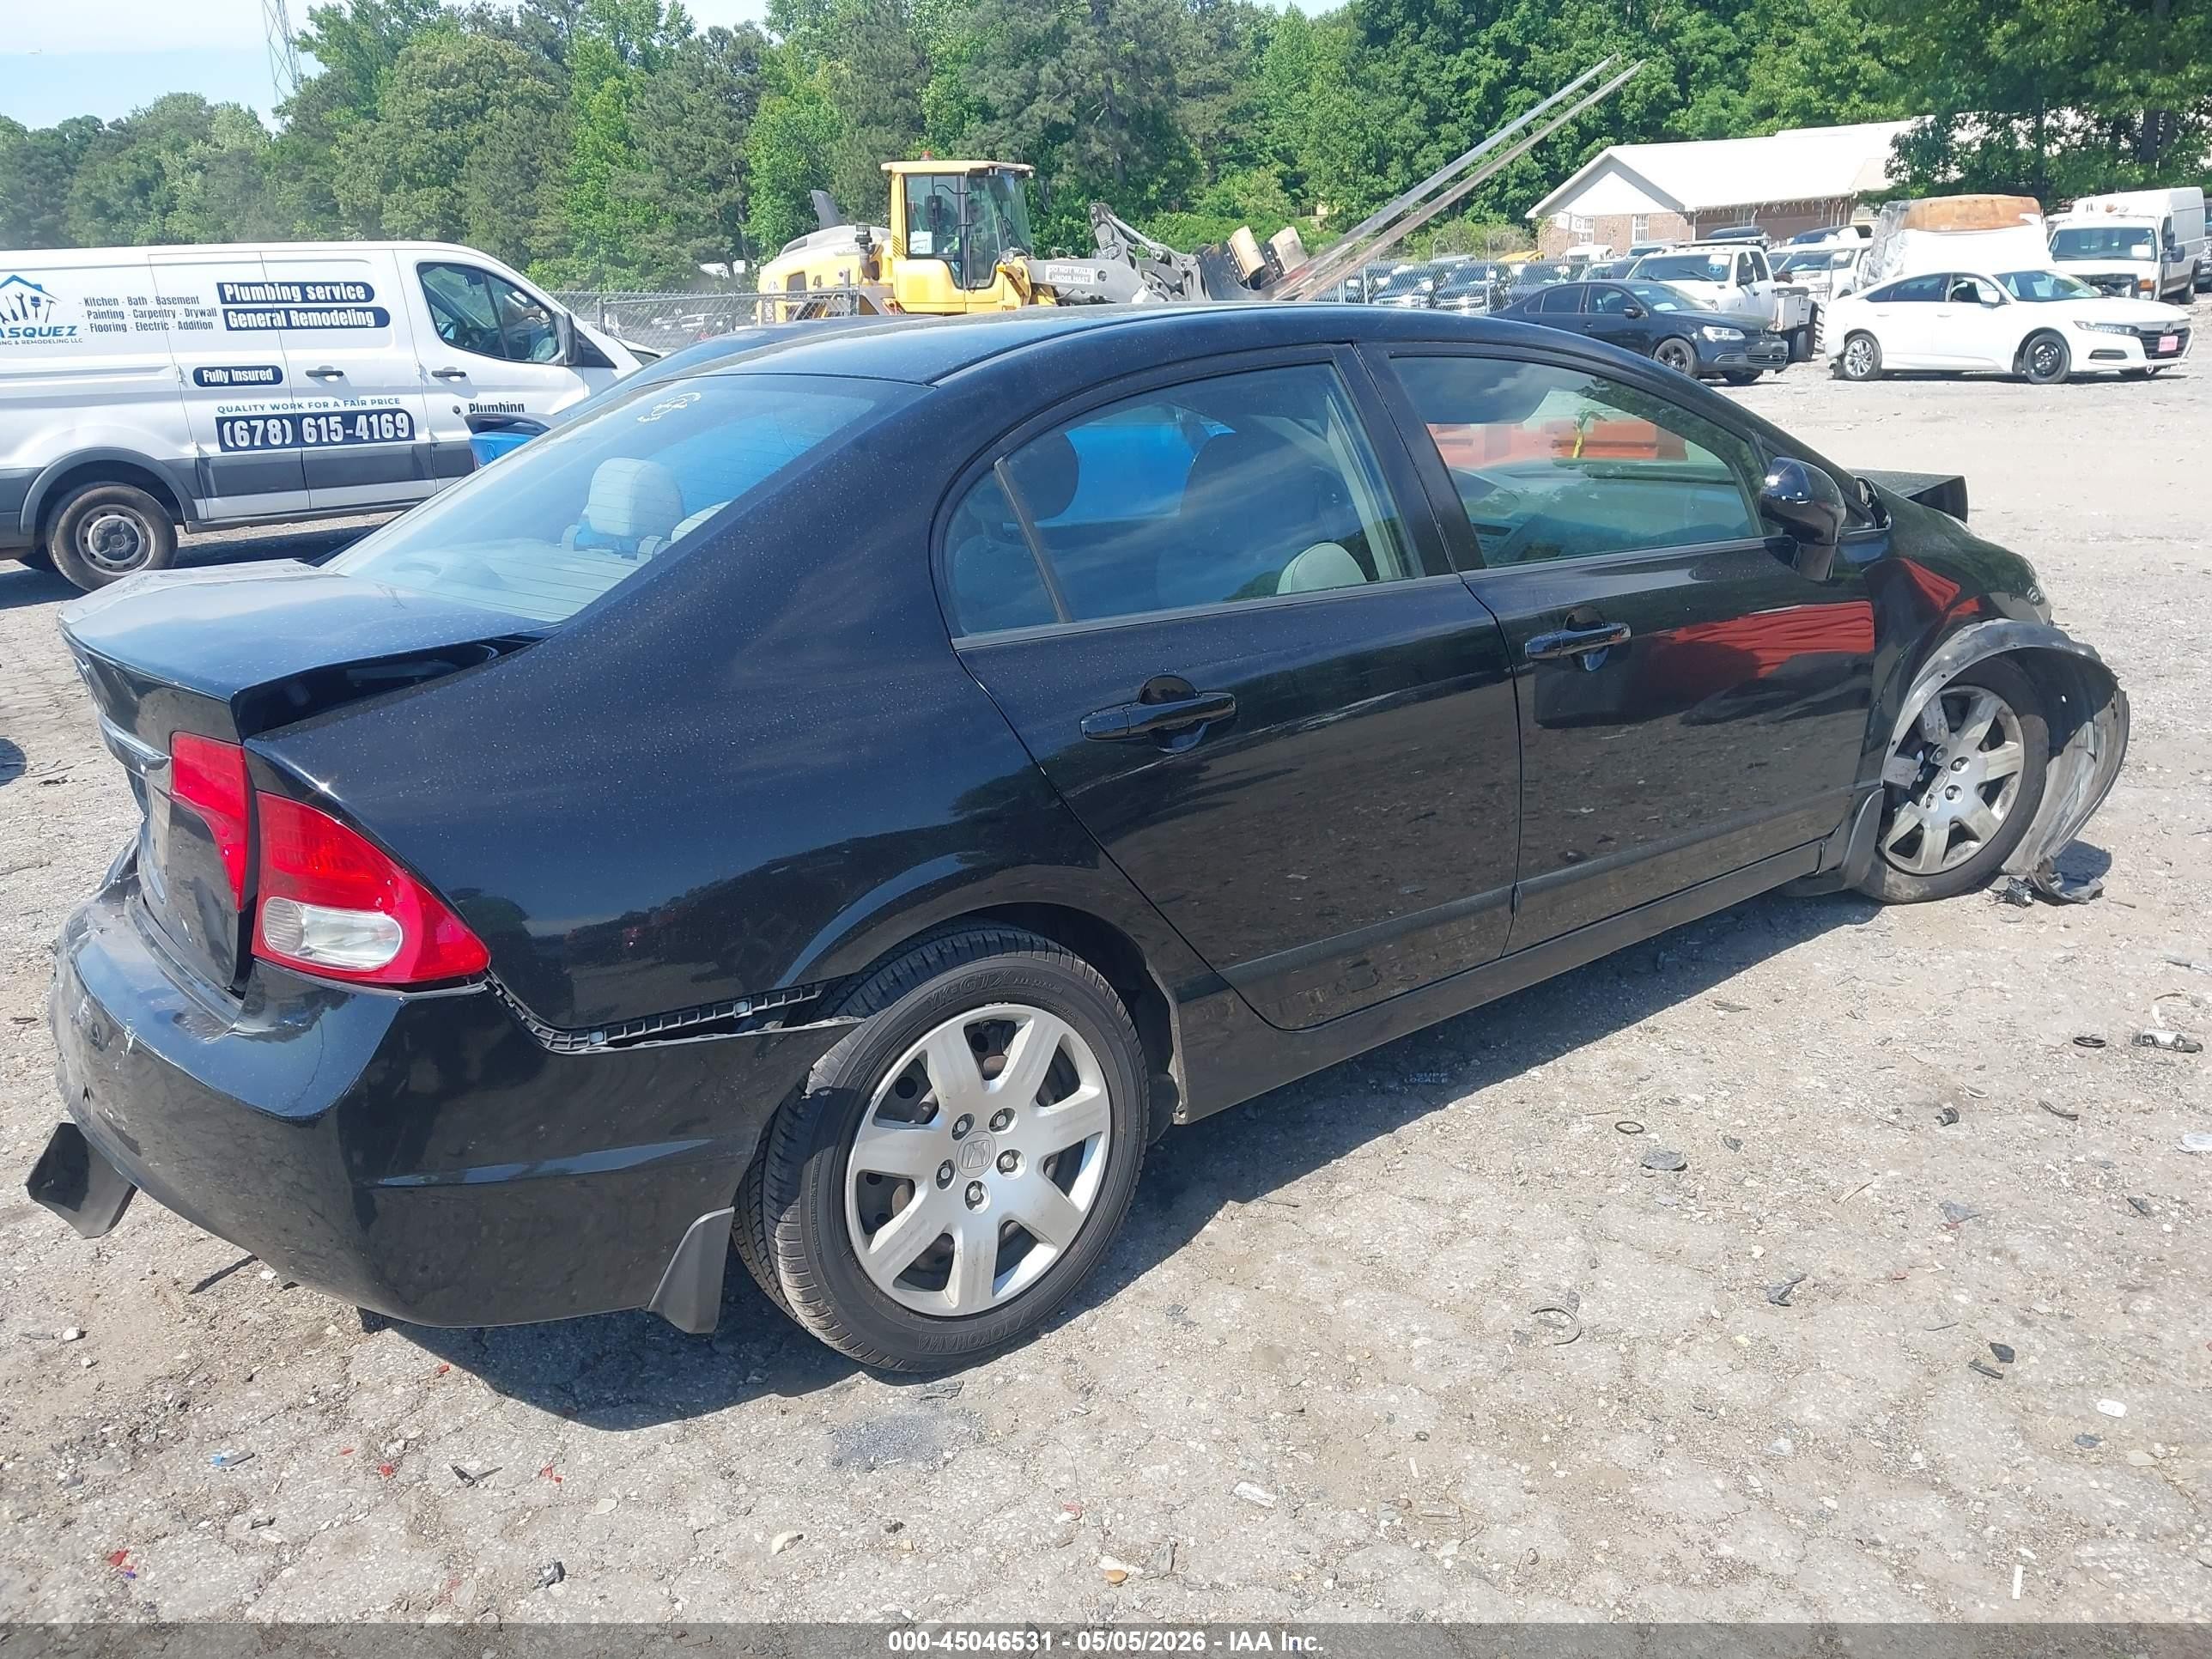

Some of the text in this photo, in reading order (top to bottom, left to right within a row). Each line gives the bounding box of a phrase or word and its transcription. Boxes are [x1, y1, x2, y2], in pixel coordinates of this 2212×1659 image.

[83, 295, 119, 307] Kitchen
[126, 295, 148, 307] Bath
[155, 295, 200, 306] Basement
[222, 283, 366, 302] Plumbing service
[86, 308, 125, 321] Painting
[132, 307, 176, 320] Carpentry
[184, 307, 217, 319] Drywall
[227, 307, 375, 328] General Remodeling
[89, 321, 128, 334] Flooring
[135, 319, 169, 332] Electric
[177, 319, 214, 331] Addition
[202, 368, 274, 385] Fully Insured
[216, 397, 401, 415] QUALITY WORK FOR A FAIR PRICE
[222, 412, 410, 448] (678) 615-4169
